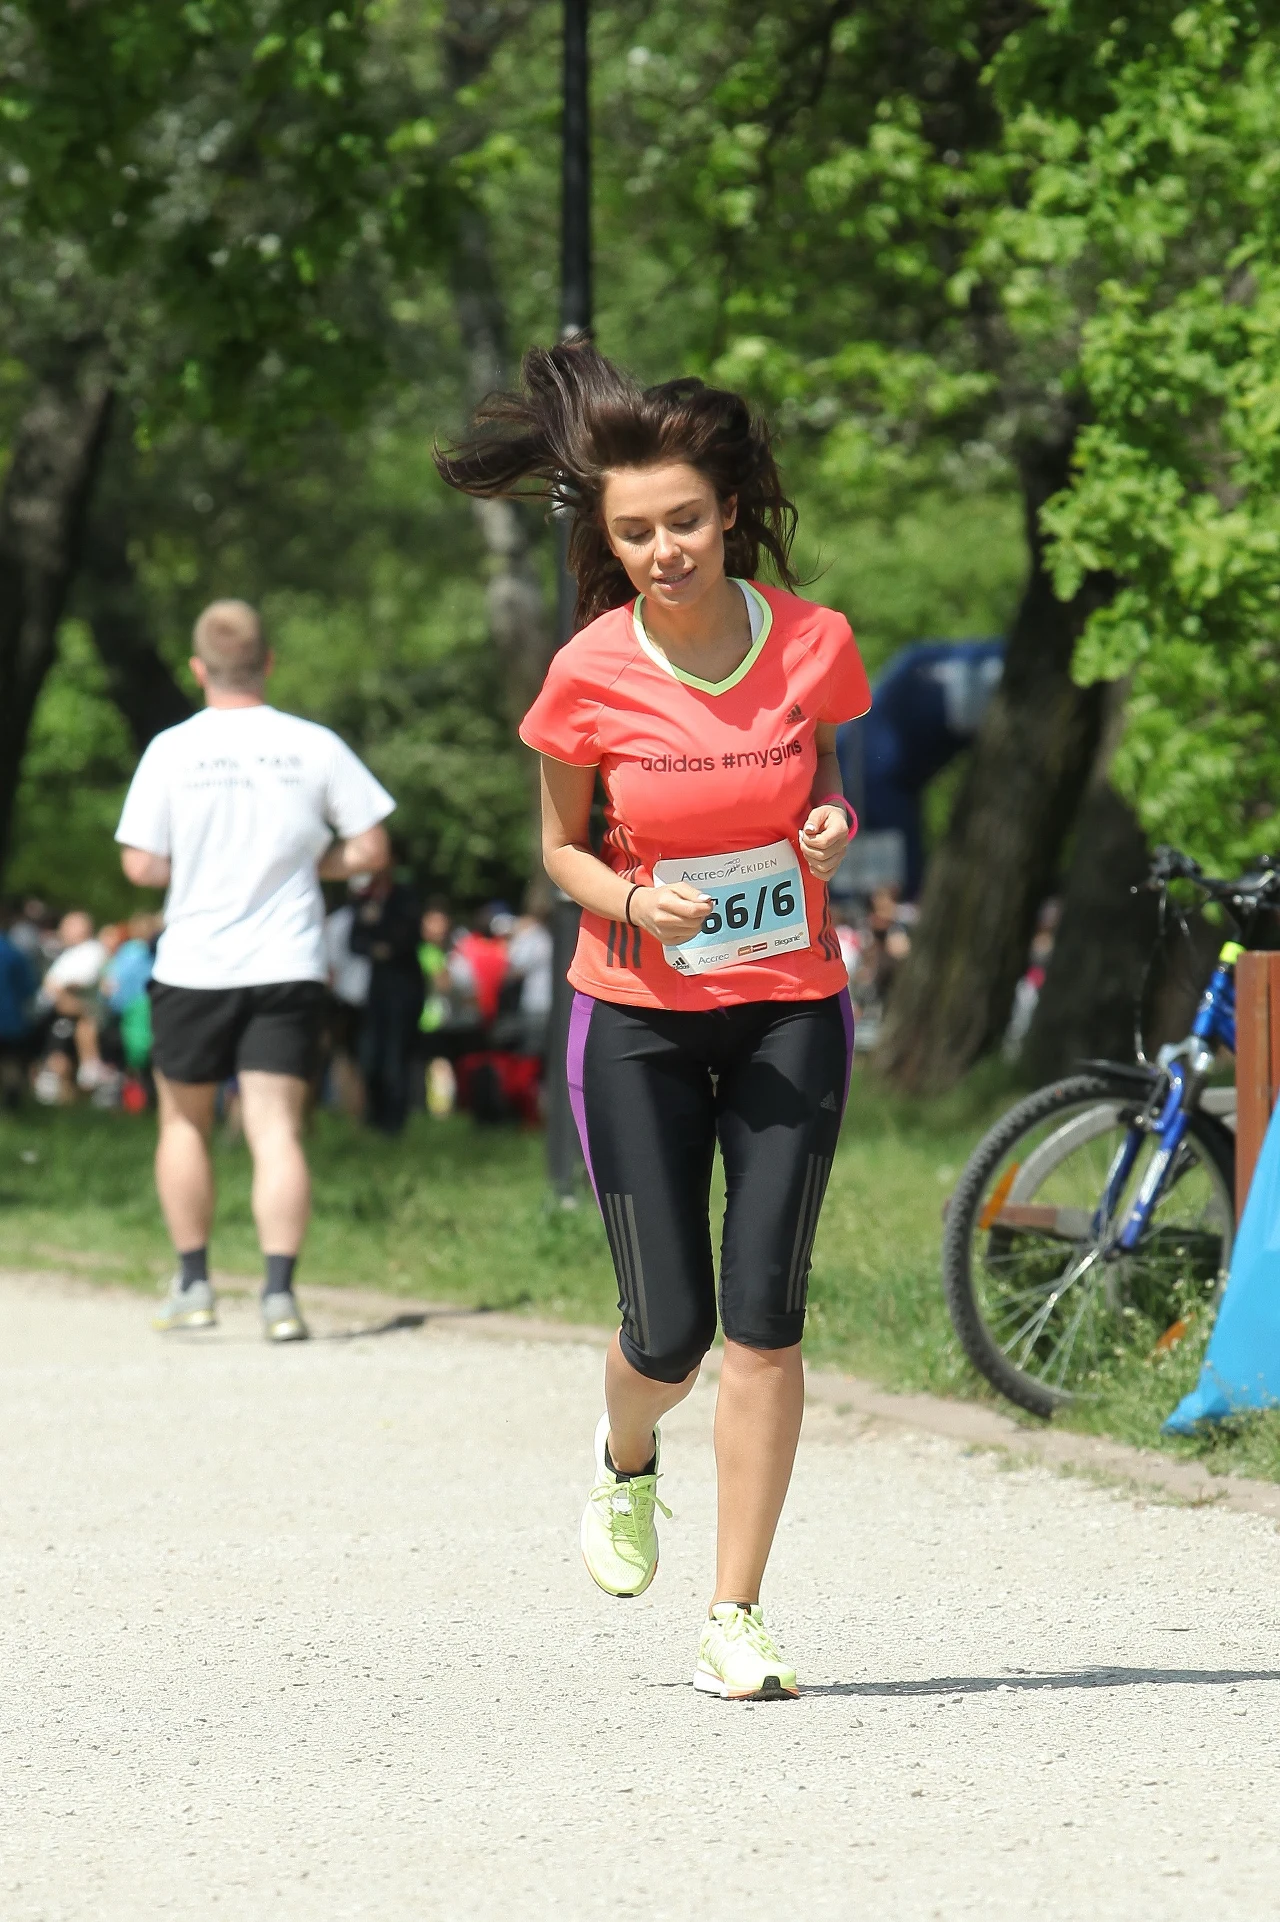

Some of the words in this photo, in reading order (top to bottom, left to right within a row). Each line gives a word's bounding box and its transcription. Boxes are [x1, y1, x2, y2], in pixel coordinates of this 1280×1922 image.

[641, 754, 715, 773] adidas
[681, 870, 725, 882] Accreo
[740, 858, 778, 875] EKIDEN
